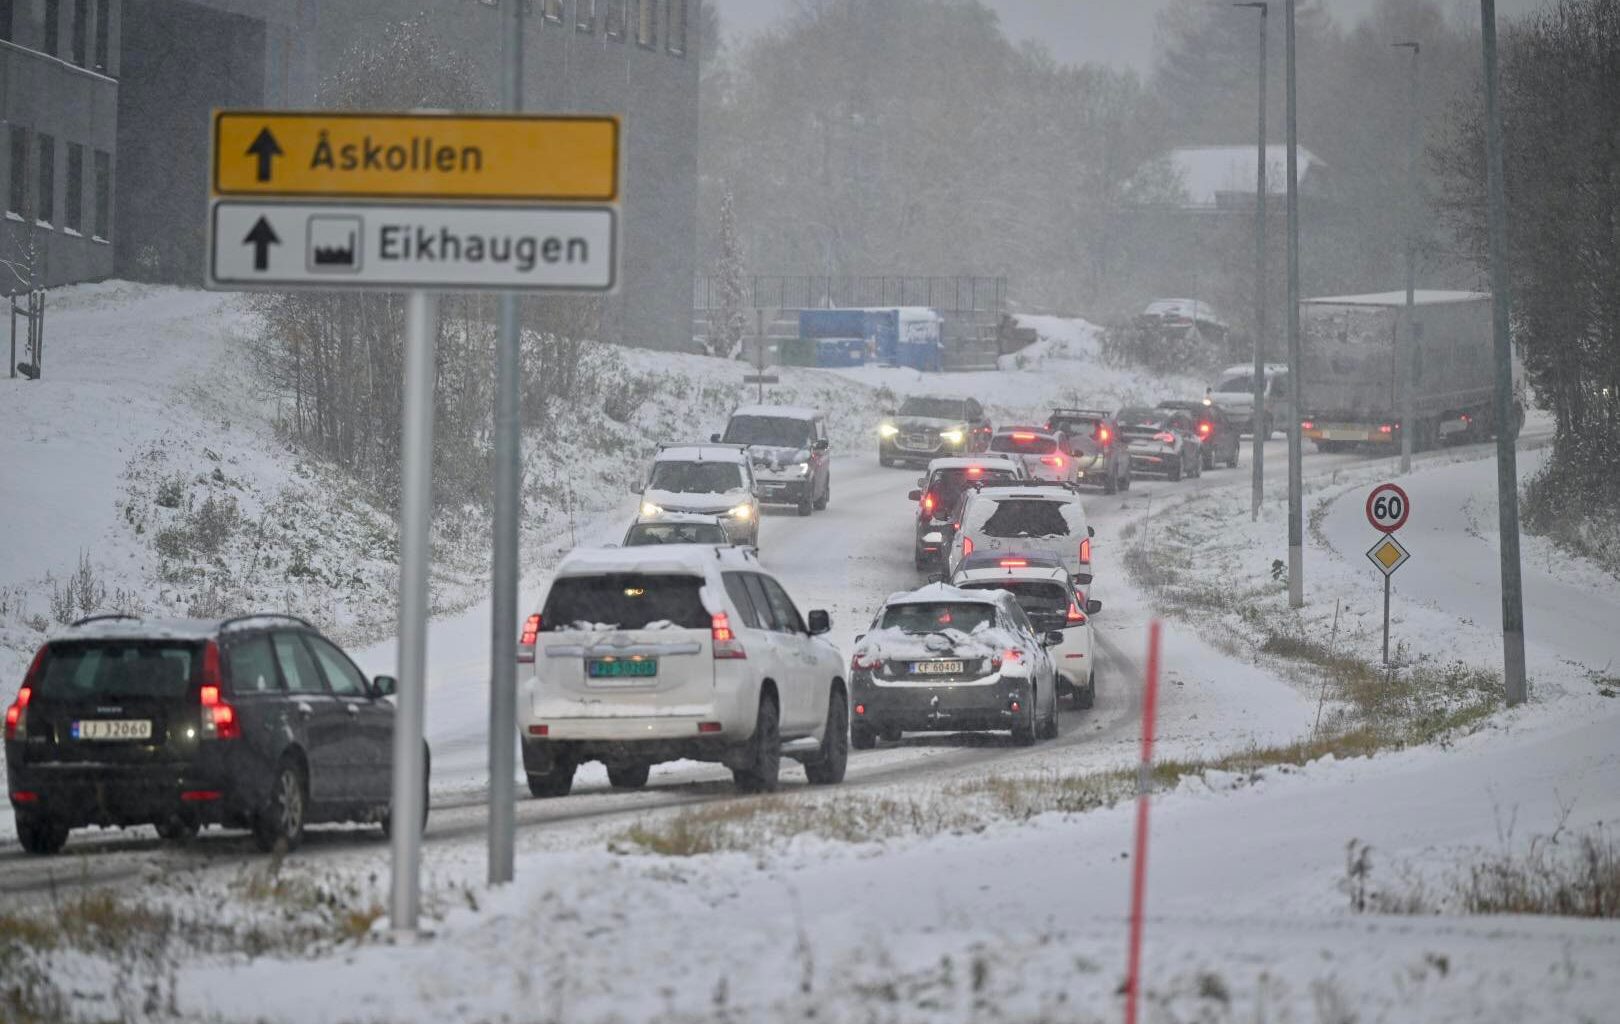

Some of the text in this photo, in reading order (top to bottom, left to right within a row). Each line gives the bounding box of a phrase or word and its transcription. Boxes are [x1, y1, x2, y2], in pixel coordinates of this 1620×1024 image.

[310, 129, 483, 172] Åskollen
[378, 225, 589, 272] Eikhaugen
[1374, 497, 1402, 519] 60
